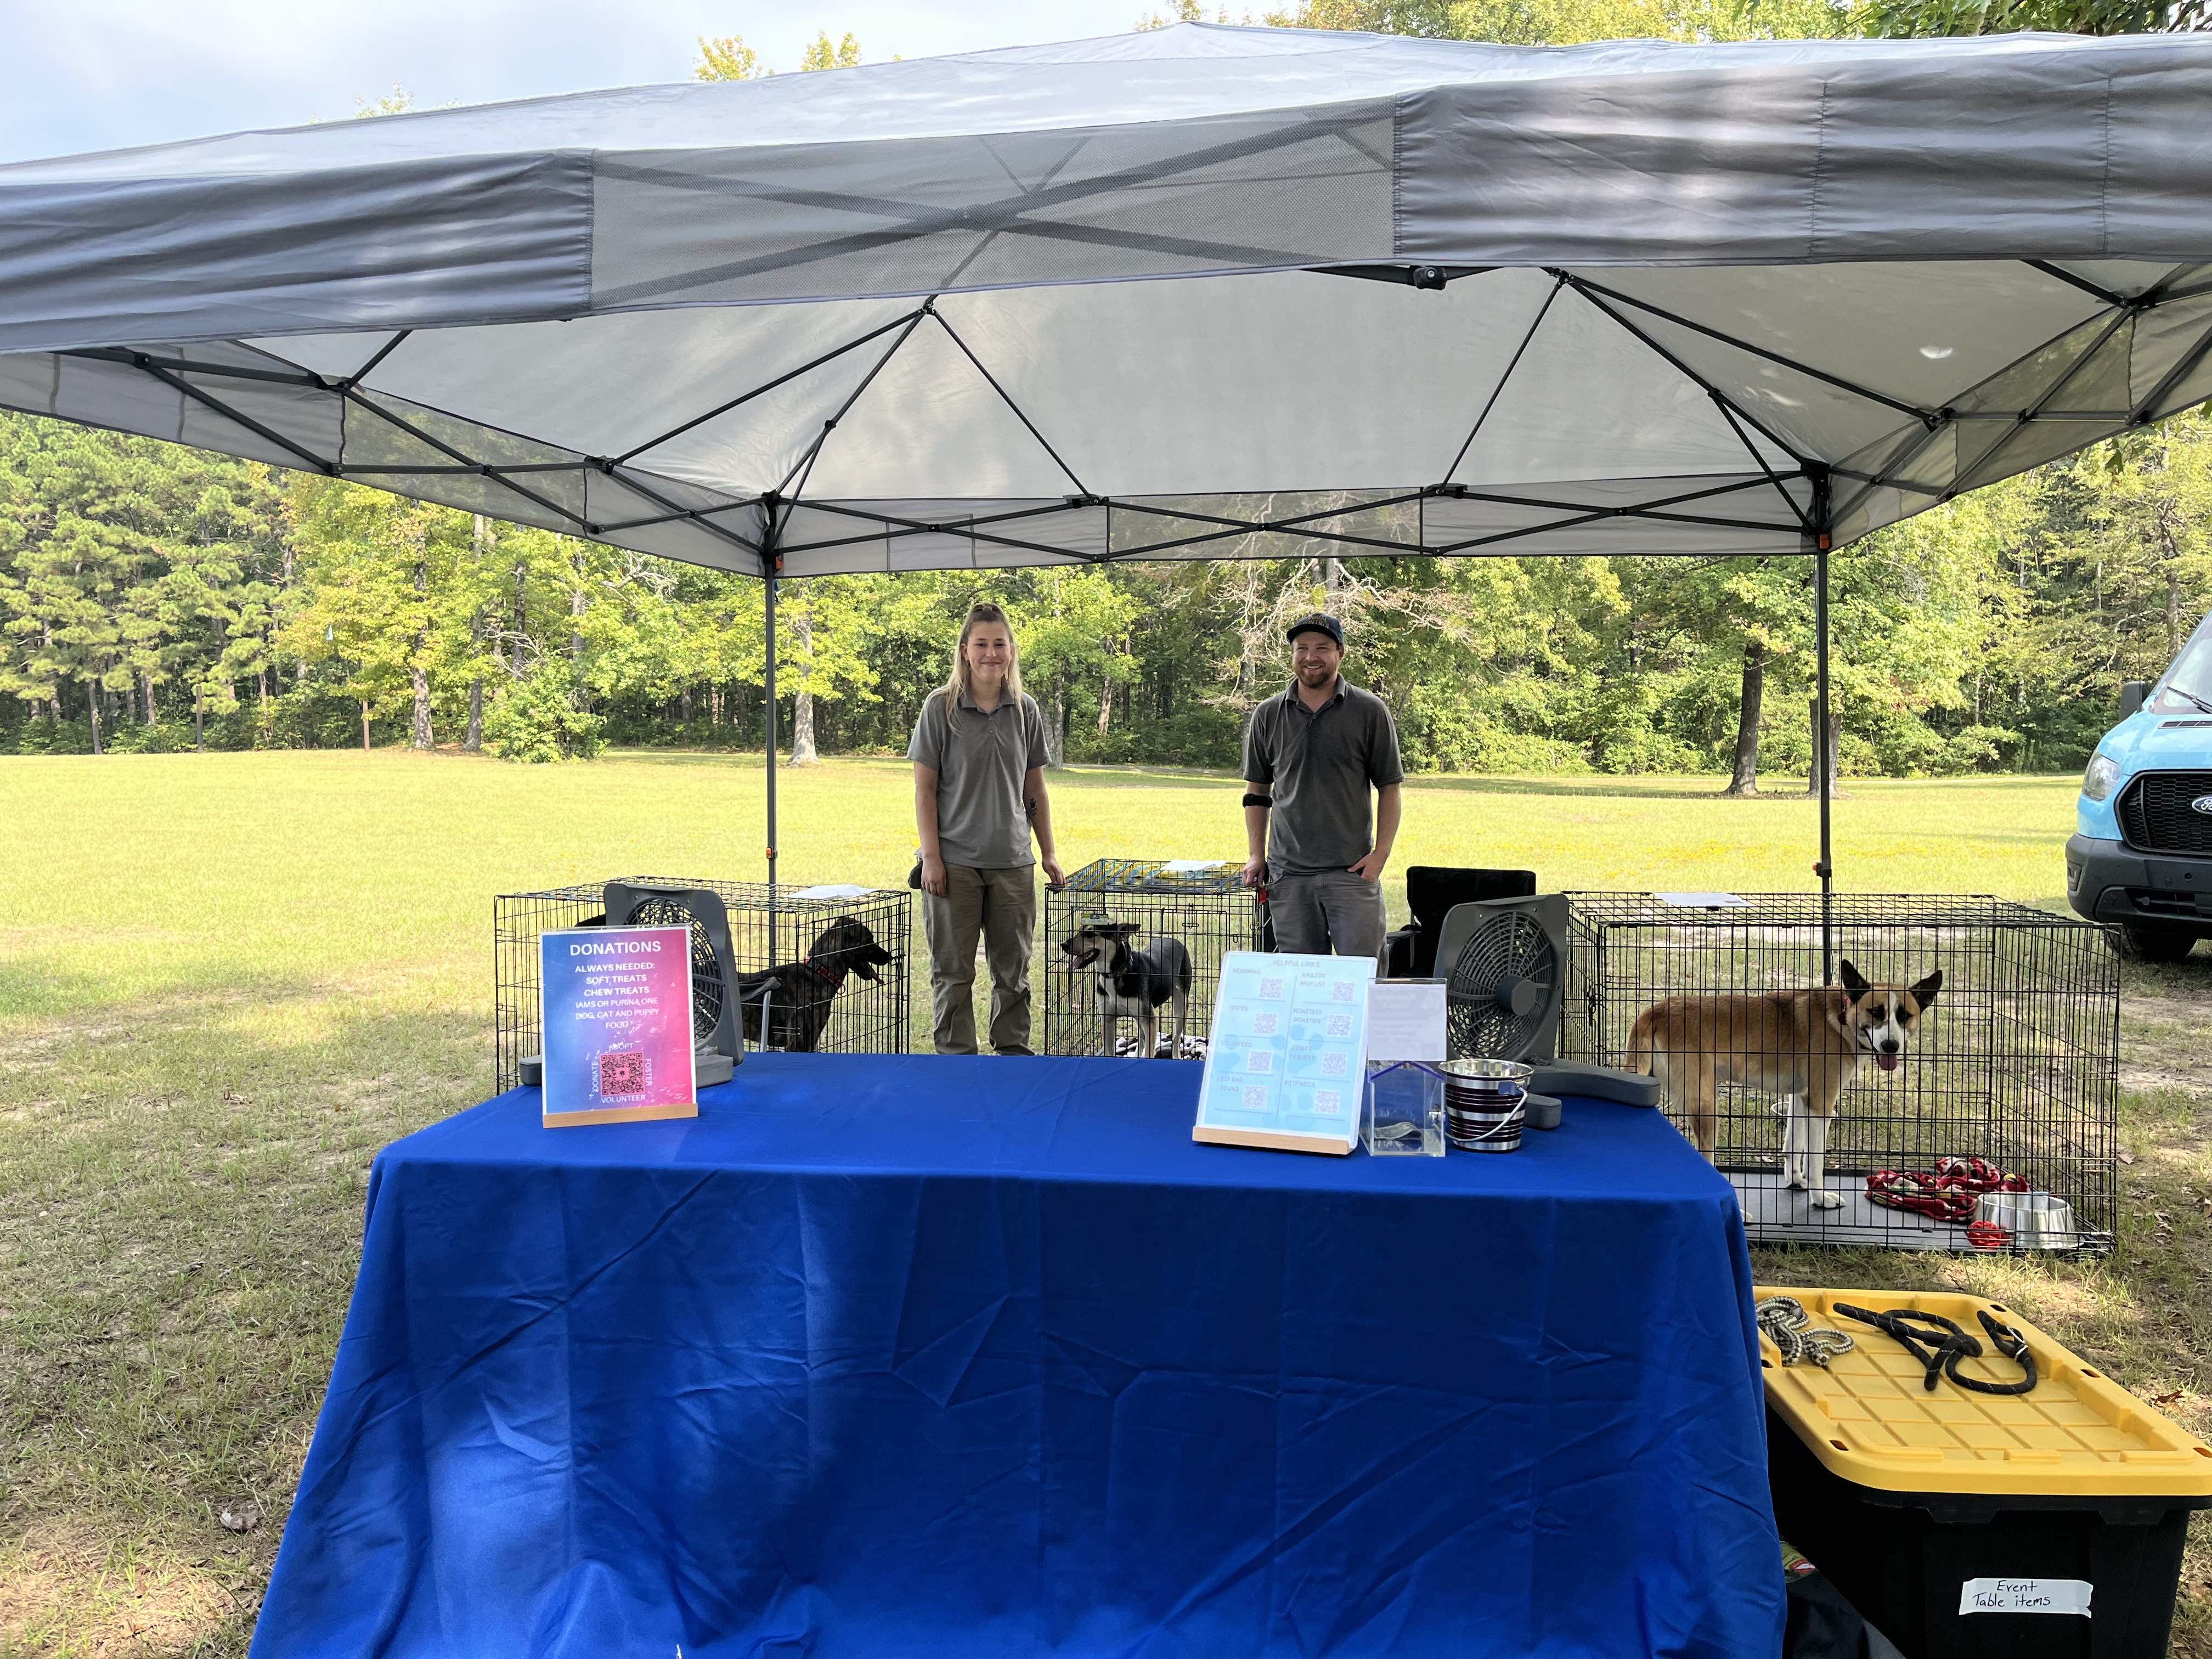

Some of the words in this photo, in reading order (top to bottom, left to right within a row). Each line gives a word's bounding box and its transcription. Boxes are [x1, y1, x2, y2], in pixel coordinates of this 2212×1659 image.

[570, 941, 662, 956] DONATIONS
[575, 964, 614, 973] ALWAYS
[616, 962, 656, 970] NEEDED:
[612, 974, 647, 983] TREATS
[614, 986, 650, 995] TREATS
[601, 1094, 646, 1103] VOLUNTEER
[1996, 1579, 2038, 1592] Event
[1972, 1592, 2005, 1607] Table
[2015, 1595, 2051, 1607] items
